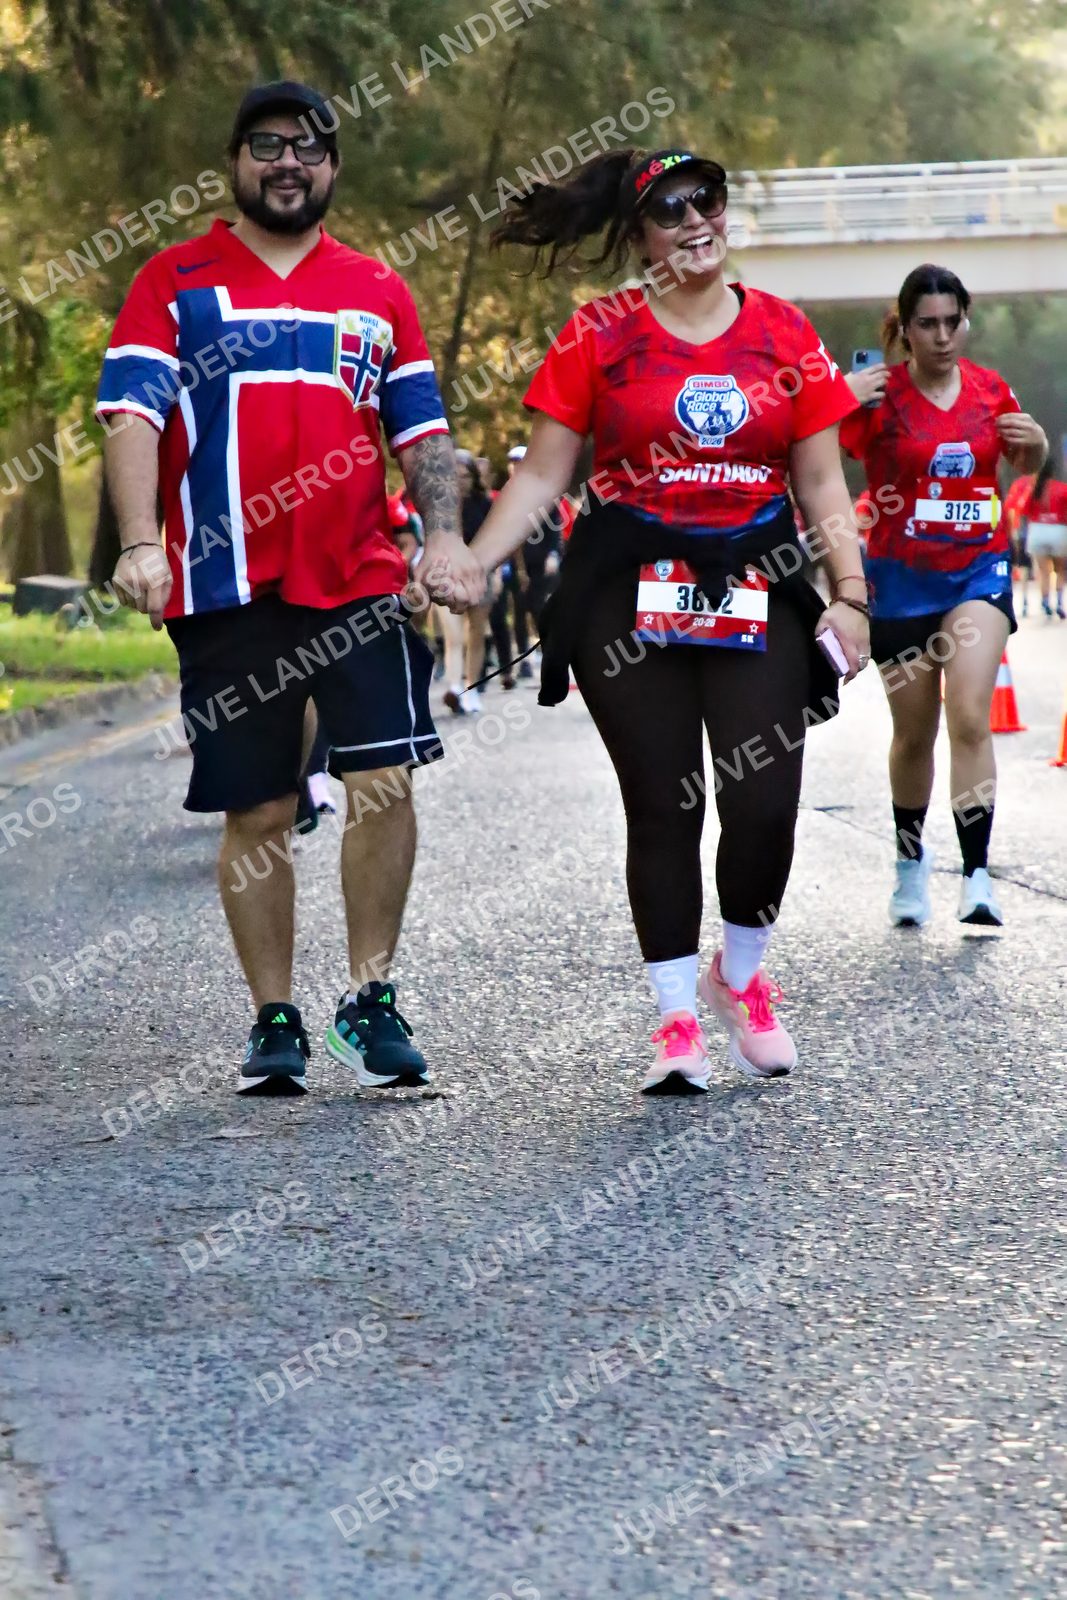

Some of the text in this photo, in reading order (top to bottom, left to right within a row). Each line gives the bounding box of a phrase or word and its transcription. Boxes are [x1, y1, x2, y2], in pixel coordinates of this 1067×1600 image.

[692, 380, 730, 388] BIMBO
[693, 391, 731, 403] Global
[686, 401, 717, 412] Race
[701, 437, 723, 446] 2026
[659, 461, 773, 484] SANTIAGO
[944, 502, 981, 521] 3125
